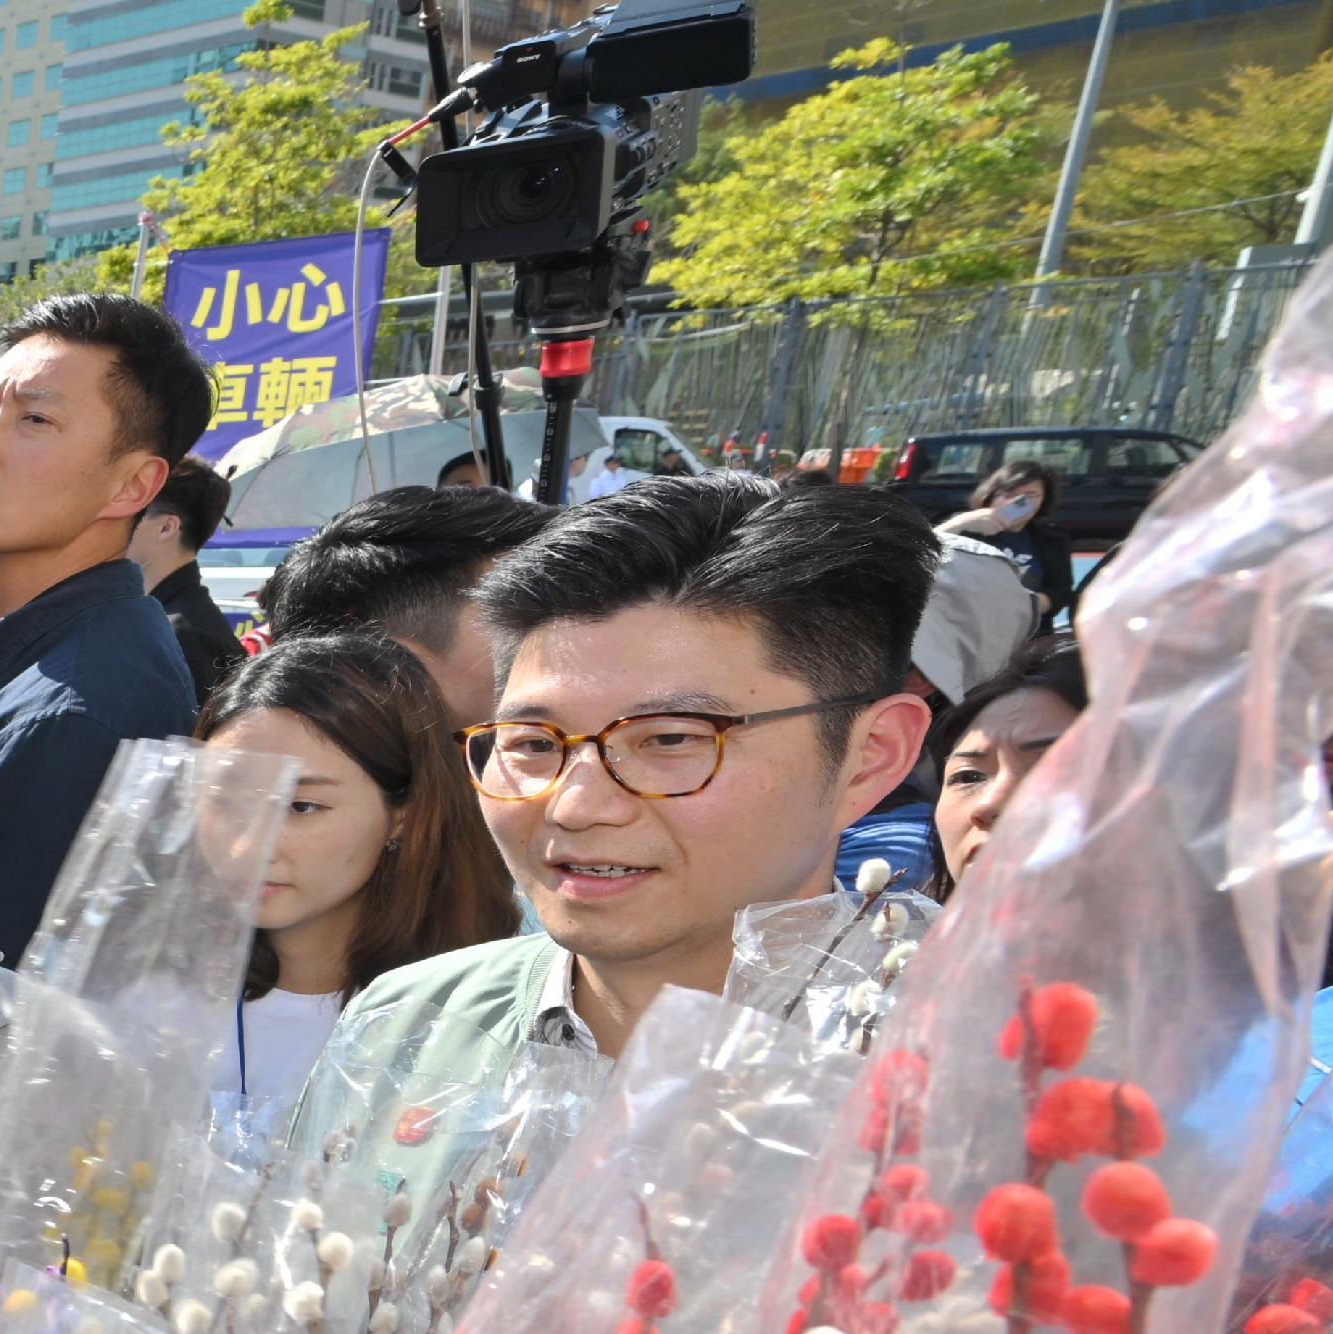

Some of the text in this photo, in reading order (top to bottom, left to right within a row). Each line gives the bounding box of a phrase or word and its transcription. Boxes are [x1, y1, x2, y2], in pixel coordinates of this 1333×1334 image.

[516, 53, 541, 63] SONY
[190, 262, 346, 340] 小心
[205, 356, 337, 431] 車輛
